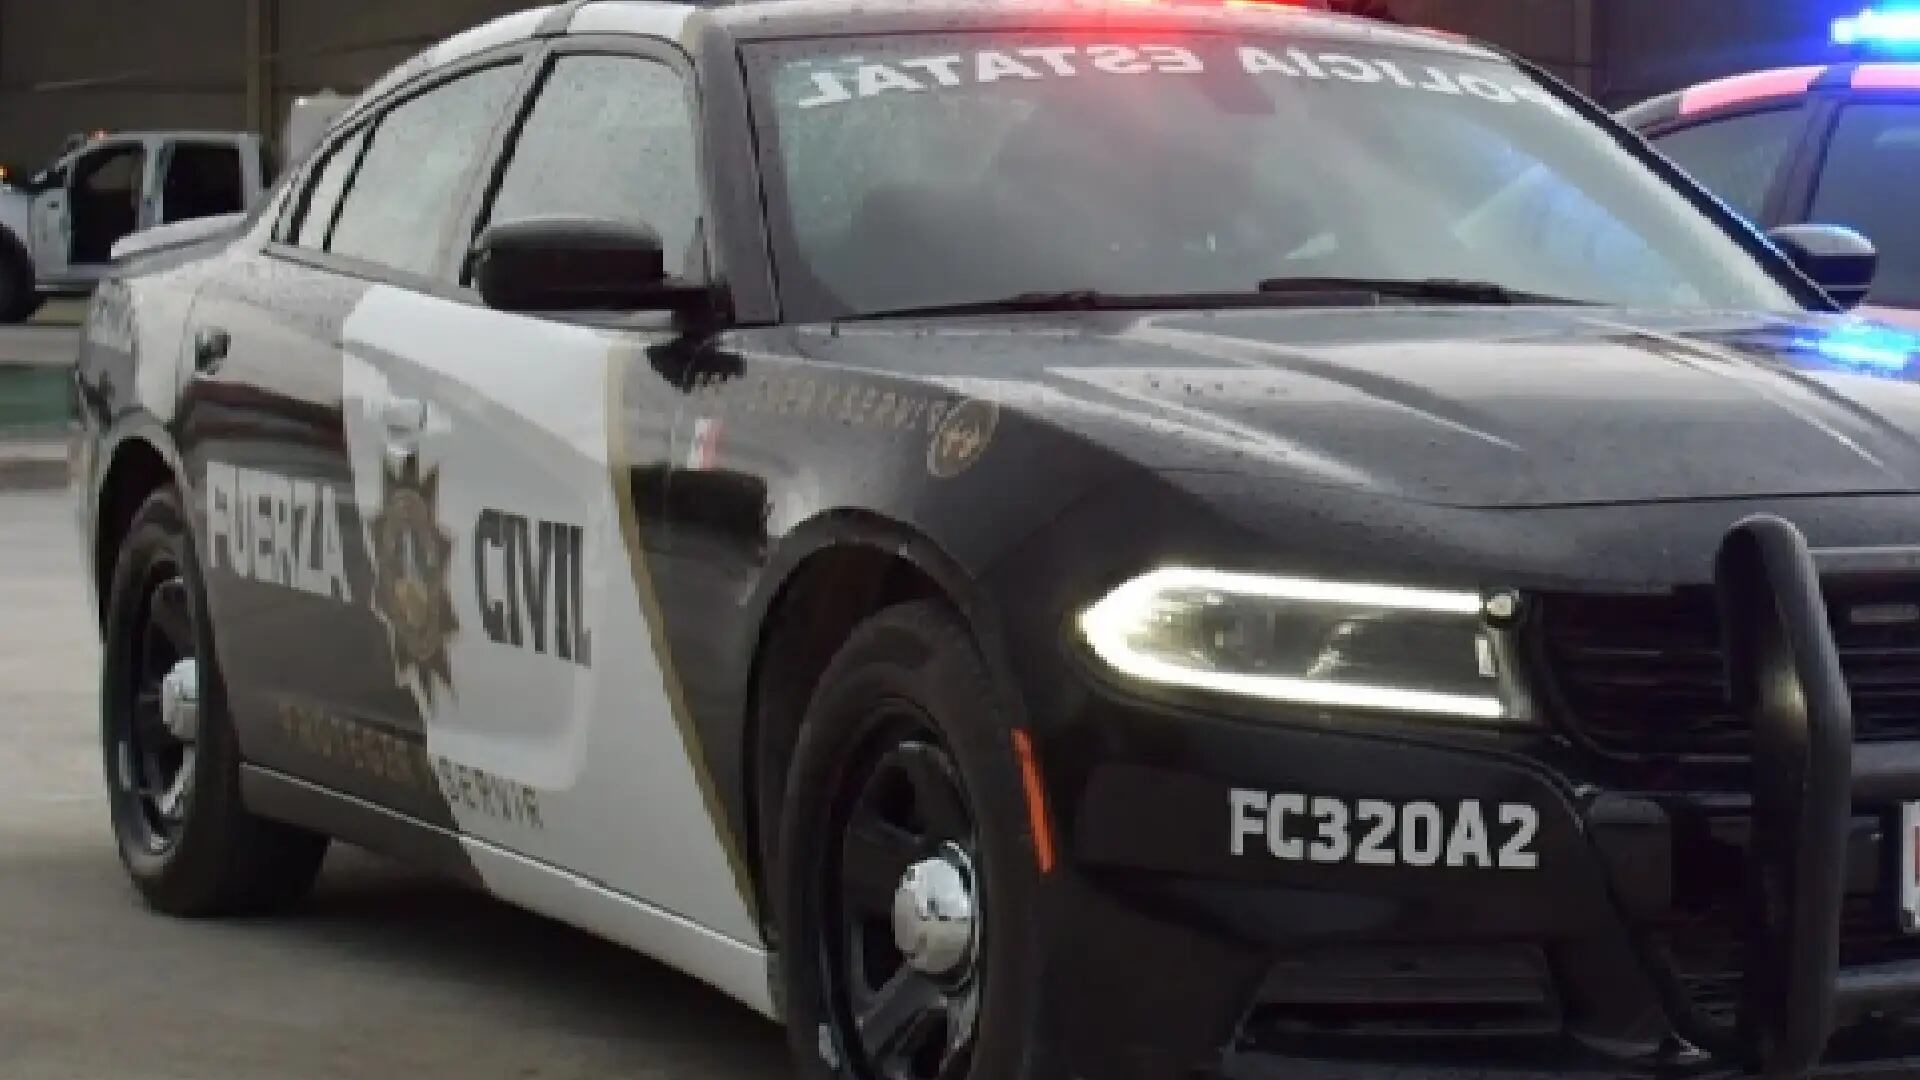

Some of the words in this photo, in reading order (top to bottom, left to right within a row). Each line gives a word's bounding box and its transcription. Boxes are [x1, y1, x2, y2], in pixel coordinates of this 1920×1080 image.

[206, 460, 352, 604] FUERZA
[474, 508, 592, 668] CIVIL
[1228, 788, 1540, 870] FC320A2
